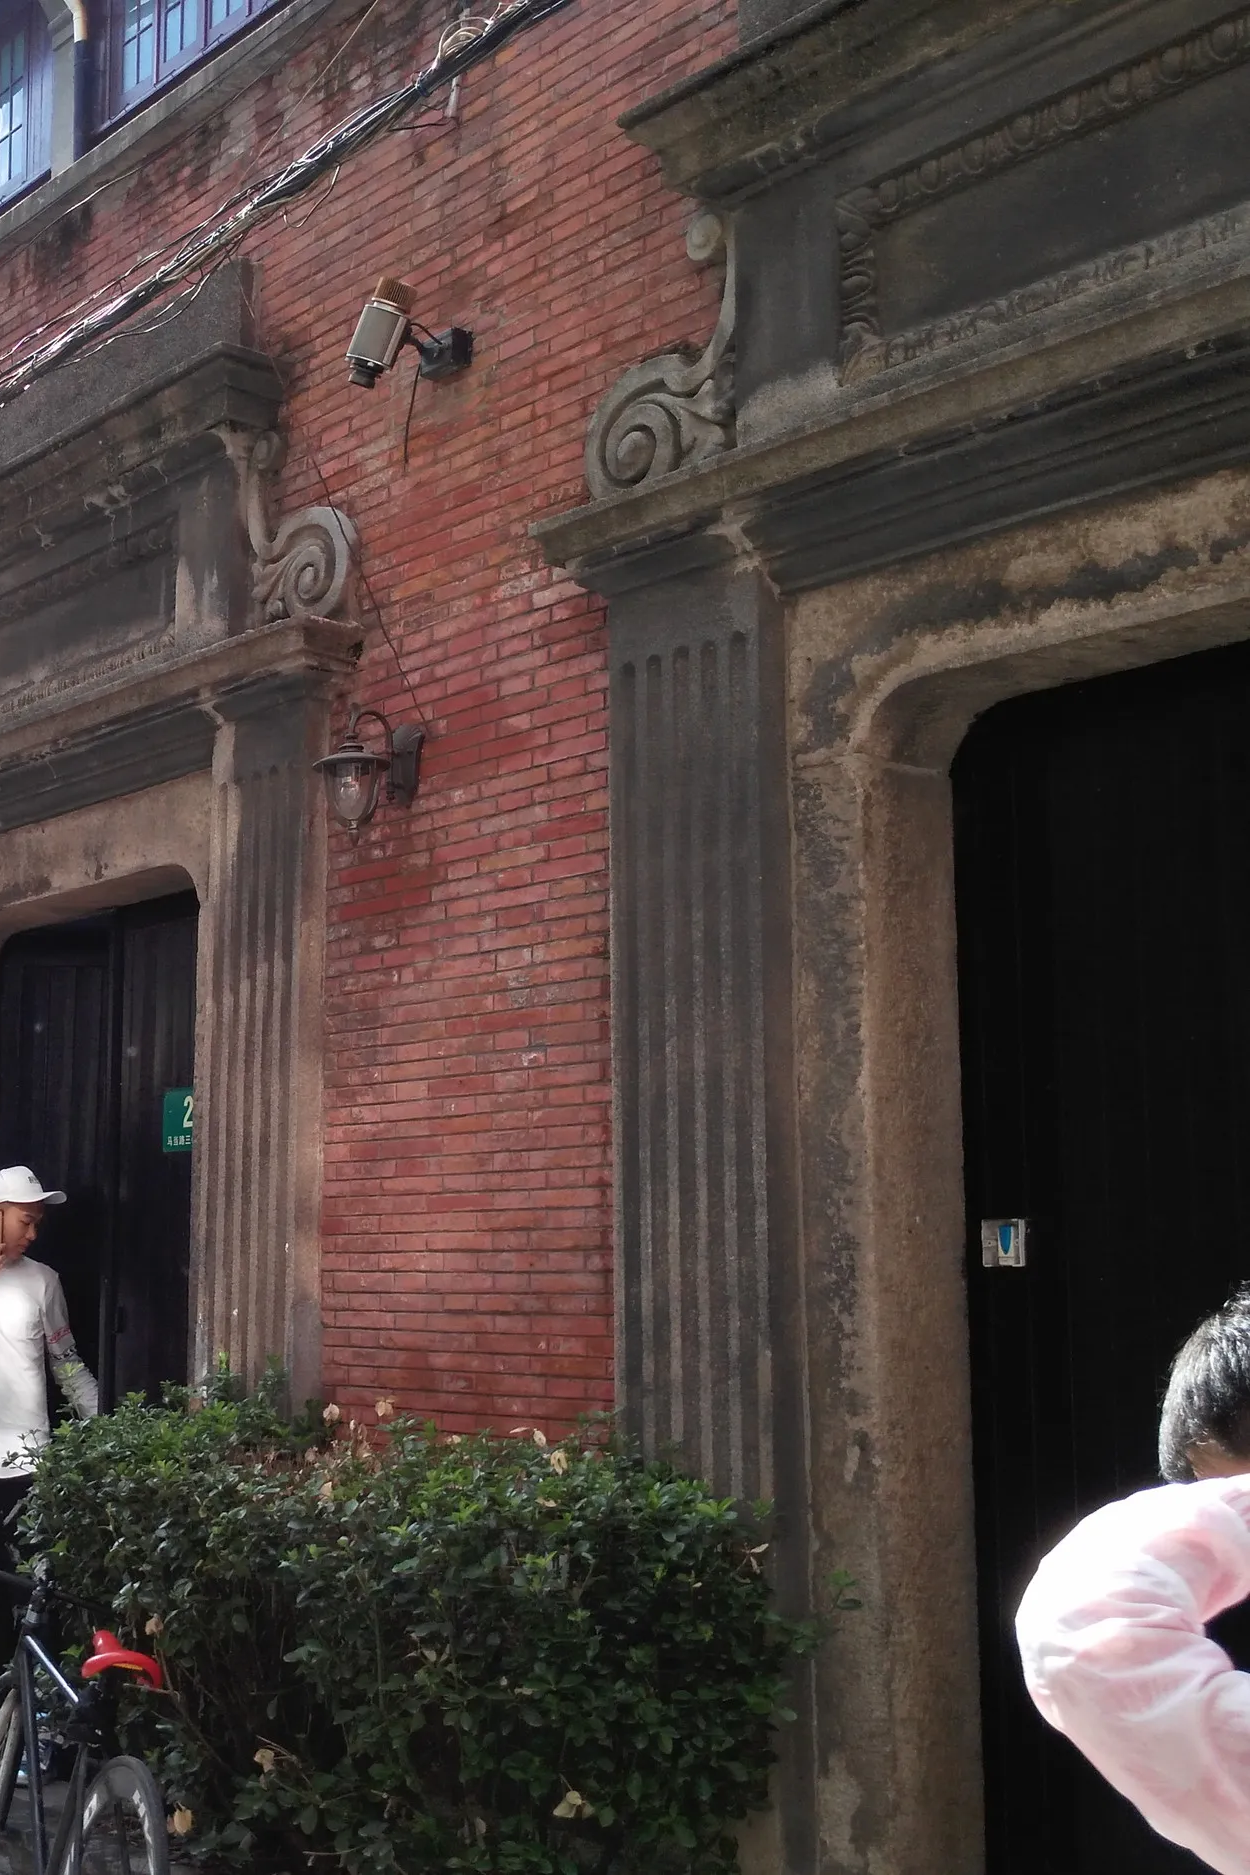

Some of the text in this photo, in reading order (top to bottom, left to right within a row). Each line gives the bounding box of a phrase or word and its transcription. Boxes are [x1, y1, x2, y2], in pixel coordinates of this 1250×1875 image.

[182, 1095, 194, 1128] 2
[166, 1135, 193, 1147] 马当路三
